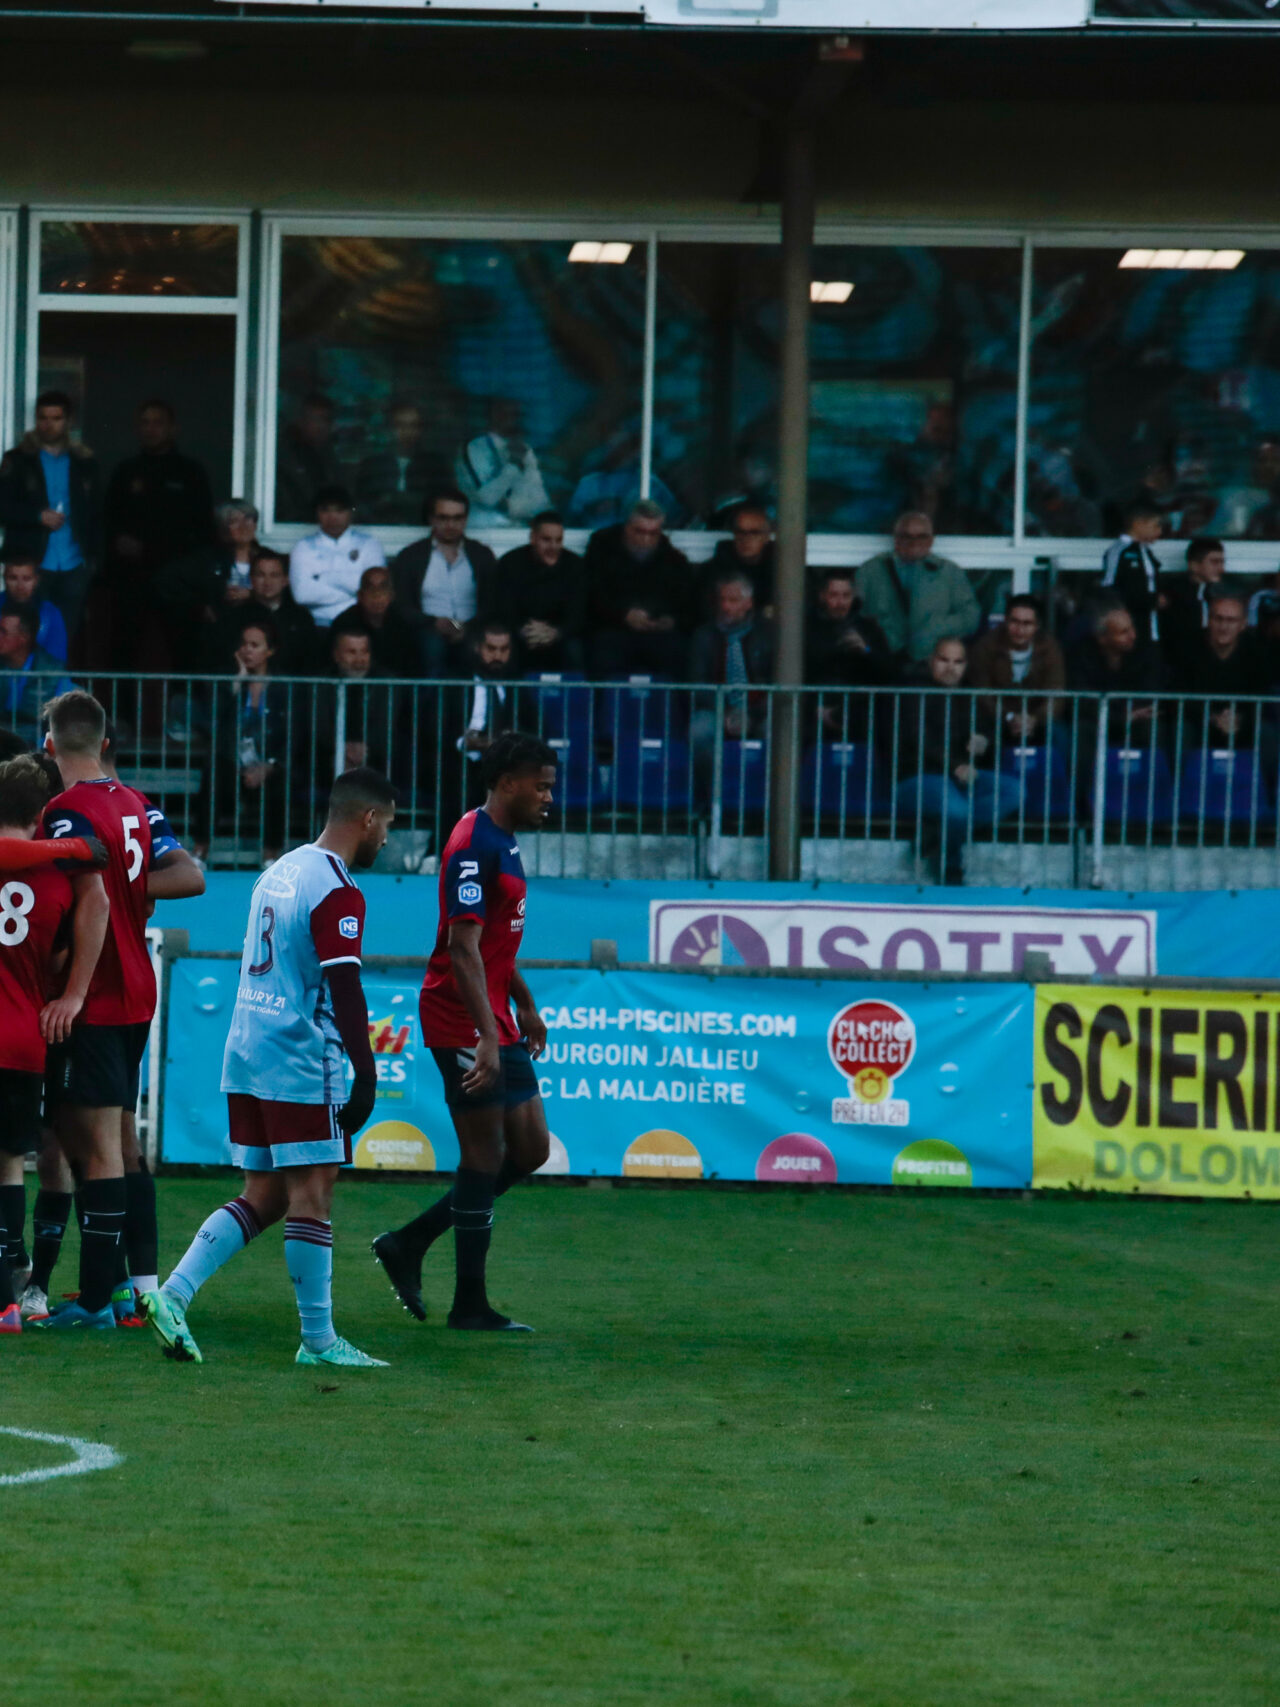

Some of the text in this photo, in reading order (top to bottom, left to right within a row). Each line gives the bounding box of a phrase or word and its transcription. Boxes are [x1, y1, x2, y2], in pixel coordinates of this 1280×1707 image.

[122, 815, 144, 883] 5
[462, 888, 477, 898] N3
[343, 921, 358, 932] N3
[273, 996, 286, 1008] 21
[537, 1043, 758, 1071] OURGOIN JALLIEU
[836, 1041, 907, 1064] COLLECT
[1040, 1001, 1280, 1133] SCIERI
[560, 1078, 591, 1099] LA
[599, 1075, 746, 1105] MALADIÈRE
[625, 1153, 701, 1168] ENTRETENIR
[772, 1155, 822, 1172] JOUER
[896, 1159, 968, 1176] PROFITER
[1094, 1139, 1280, 1186] DOLOM
